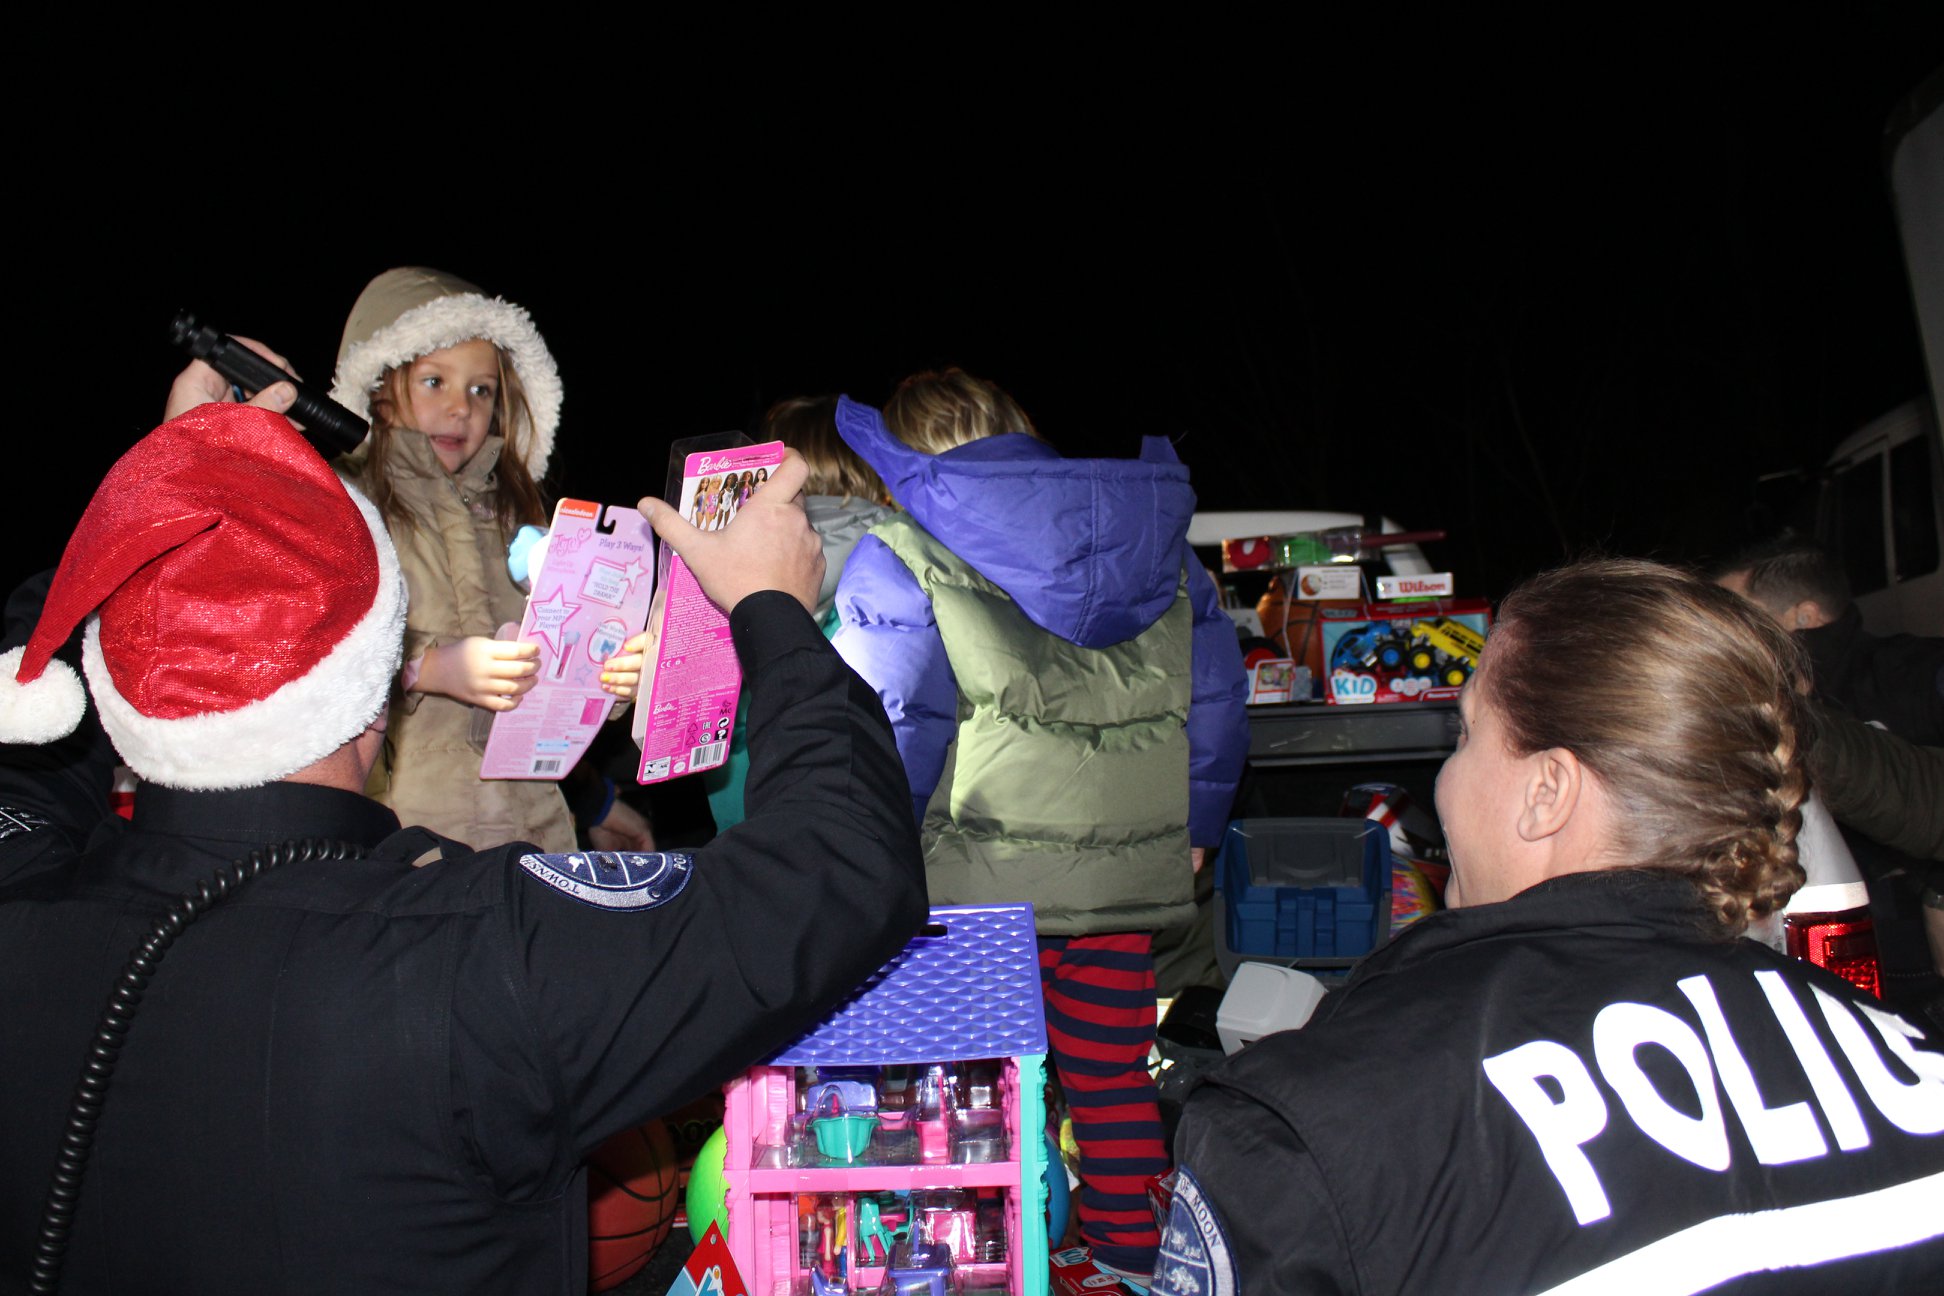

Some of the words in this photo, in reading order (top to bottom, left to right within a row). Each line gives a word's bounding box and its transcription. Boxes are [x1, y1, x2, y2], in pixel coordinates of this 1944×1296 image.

[697, 456, 732, 474] Barbie
[599, 537, 616, 549] Play
[616, 541, 622, 549] 3
[623, 541, 644, 552] Ways!
[1398, 580, 1446, 594] Wilson
[1335, 678, 1375, 695] KID
[1193, 1193, 1221, 1248] MOON
